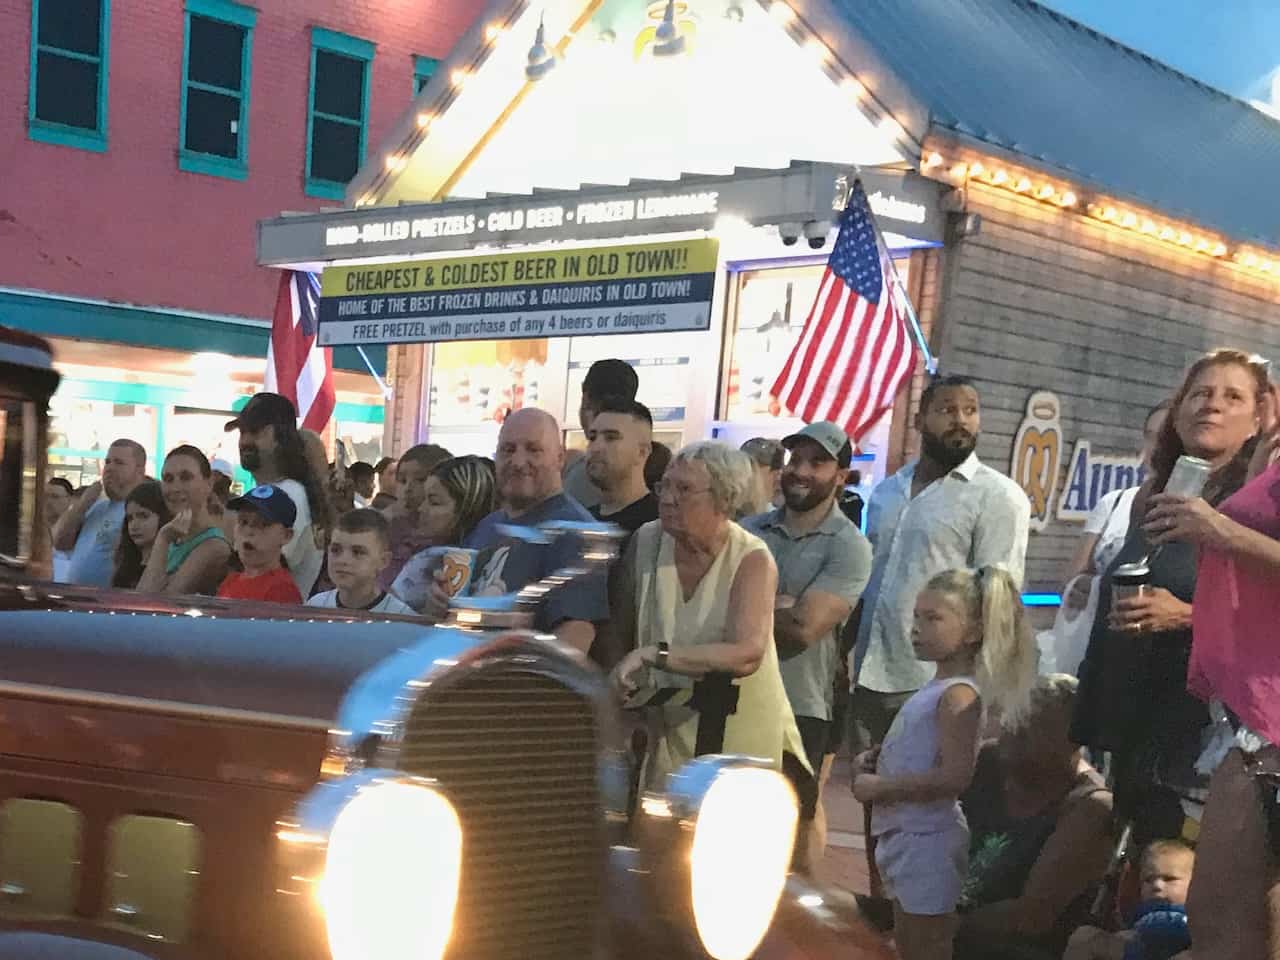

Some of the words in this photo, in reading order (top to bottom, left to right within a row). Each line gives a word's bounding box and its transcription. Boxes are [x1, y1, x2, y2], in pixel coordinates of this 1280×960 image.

[412, 214, 476, 238] PRETZELS
[487, 210, 524, 232] COLD
[526, 206, 563, 229] BEER
[576, 200, 635, 224] FROZEN
[346, 267, 420, 292] CHEAPEST
[424, 265, 435, 286] &
[441, 261, 509, 286] COLDEST
[513, 257, 557, 281] BEER
[563, 255, 581, 277] IN
[587, 253, 619, 277] OLD
[626, 247, 688, 274] TOWN!!
[338, 300, 368, 316] HOME
[370, 299, 385, 315] OF
[388, 298, 407, 313] THE
[409, 296, 436, 312] BEST
[438, 293, 482, 311] FROZEN
[484, 290, 527, 308] DRINKS
[530, 289, 539, 305] &
[542, 286, 603, 305] DAIQUIRIS
[606, 284, 621, 301] IN
[623, 282, 648, 300] OLD
[651, 279, 692, 298] TOWN!
[352, 324, 381, 339] FREE
[382, 322, 426, 338] PRETZEL
[429, 320, 452, 335] with
[454, 316, 505, 337] purchase
[509, 316, 521, 334] of
[524, 317, 545, 334] any
[548, 315, 556, 329] 4
[559, 313, 593, 330] beers
[597, 315, 609, 329] or
[614, 311, 667, 330] daiquiris
